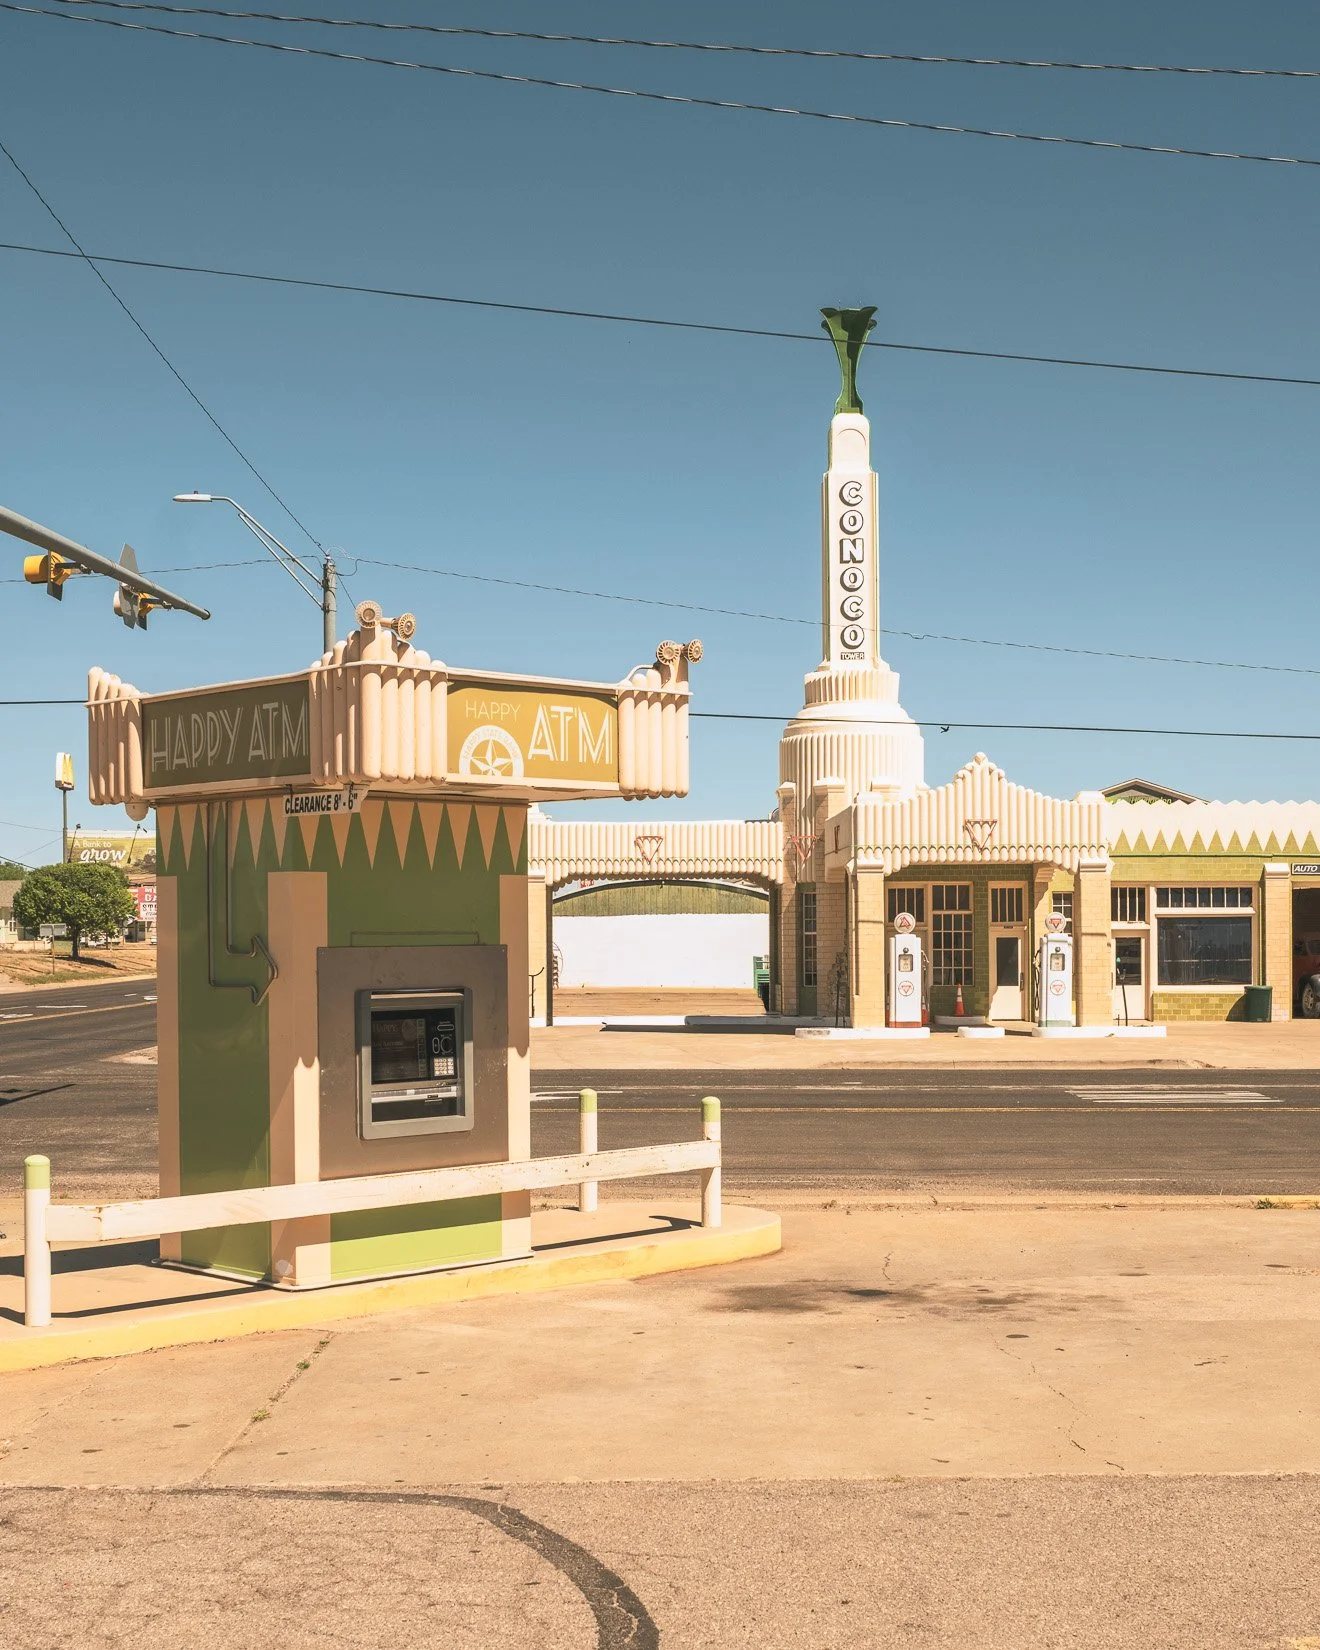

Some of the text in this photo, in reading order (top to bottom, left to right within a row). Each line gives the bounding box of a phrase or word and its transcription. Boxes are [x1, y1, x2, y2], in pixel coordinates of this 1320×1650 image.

[839, 481, 865, 650] CONOCO
[841, 652, 865, 661] TOWER
[151, 695, 309, 773] HAPPY ATM
[465, 700, 613, 765] HAPPY ATM
[285, 795, 331, 814] CLEARANCE
[73, 840, 112, 848] A Bank to
[80, 848, 127, 863] grow
[1294, 865, 1318, 873] AUTO
